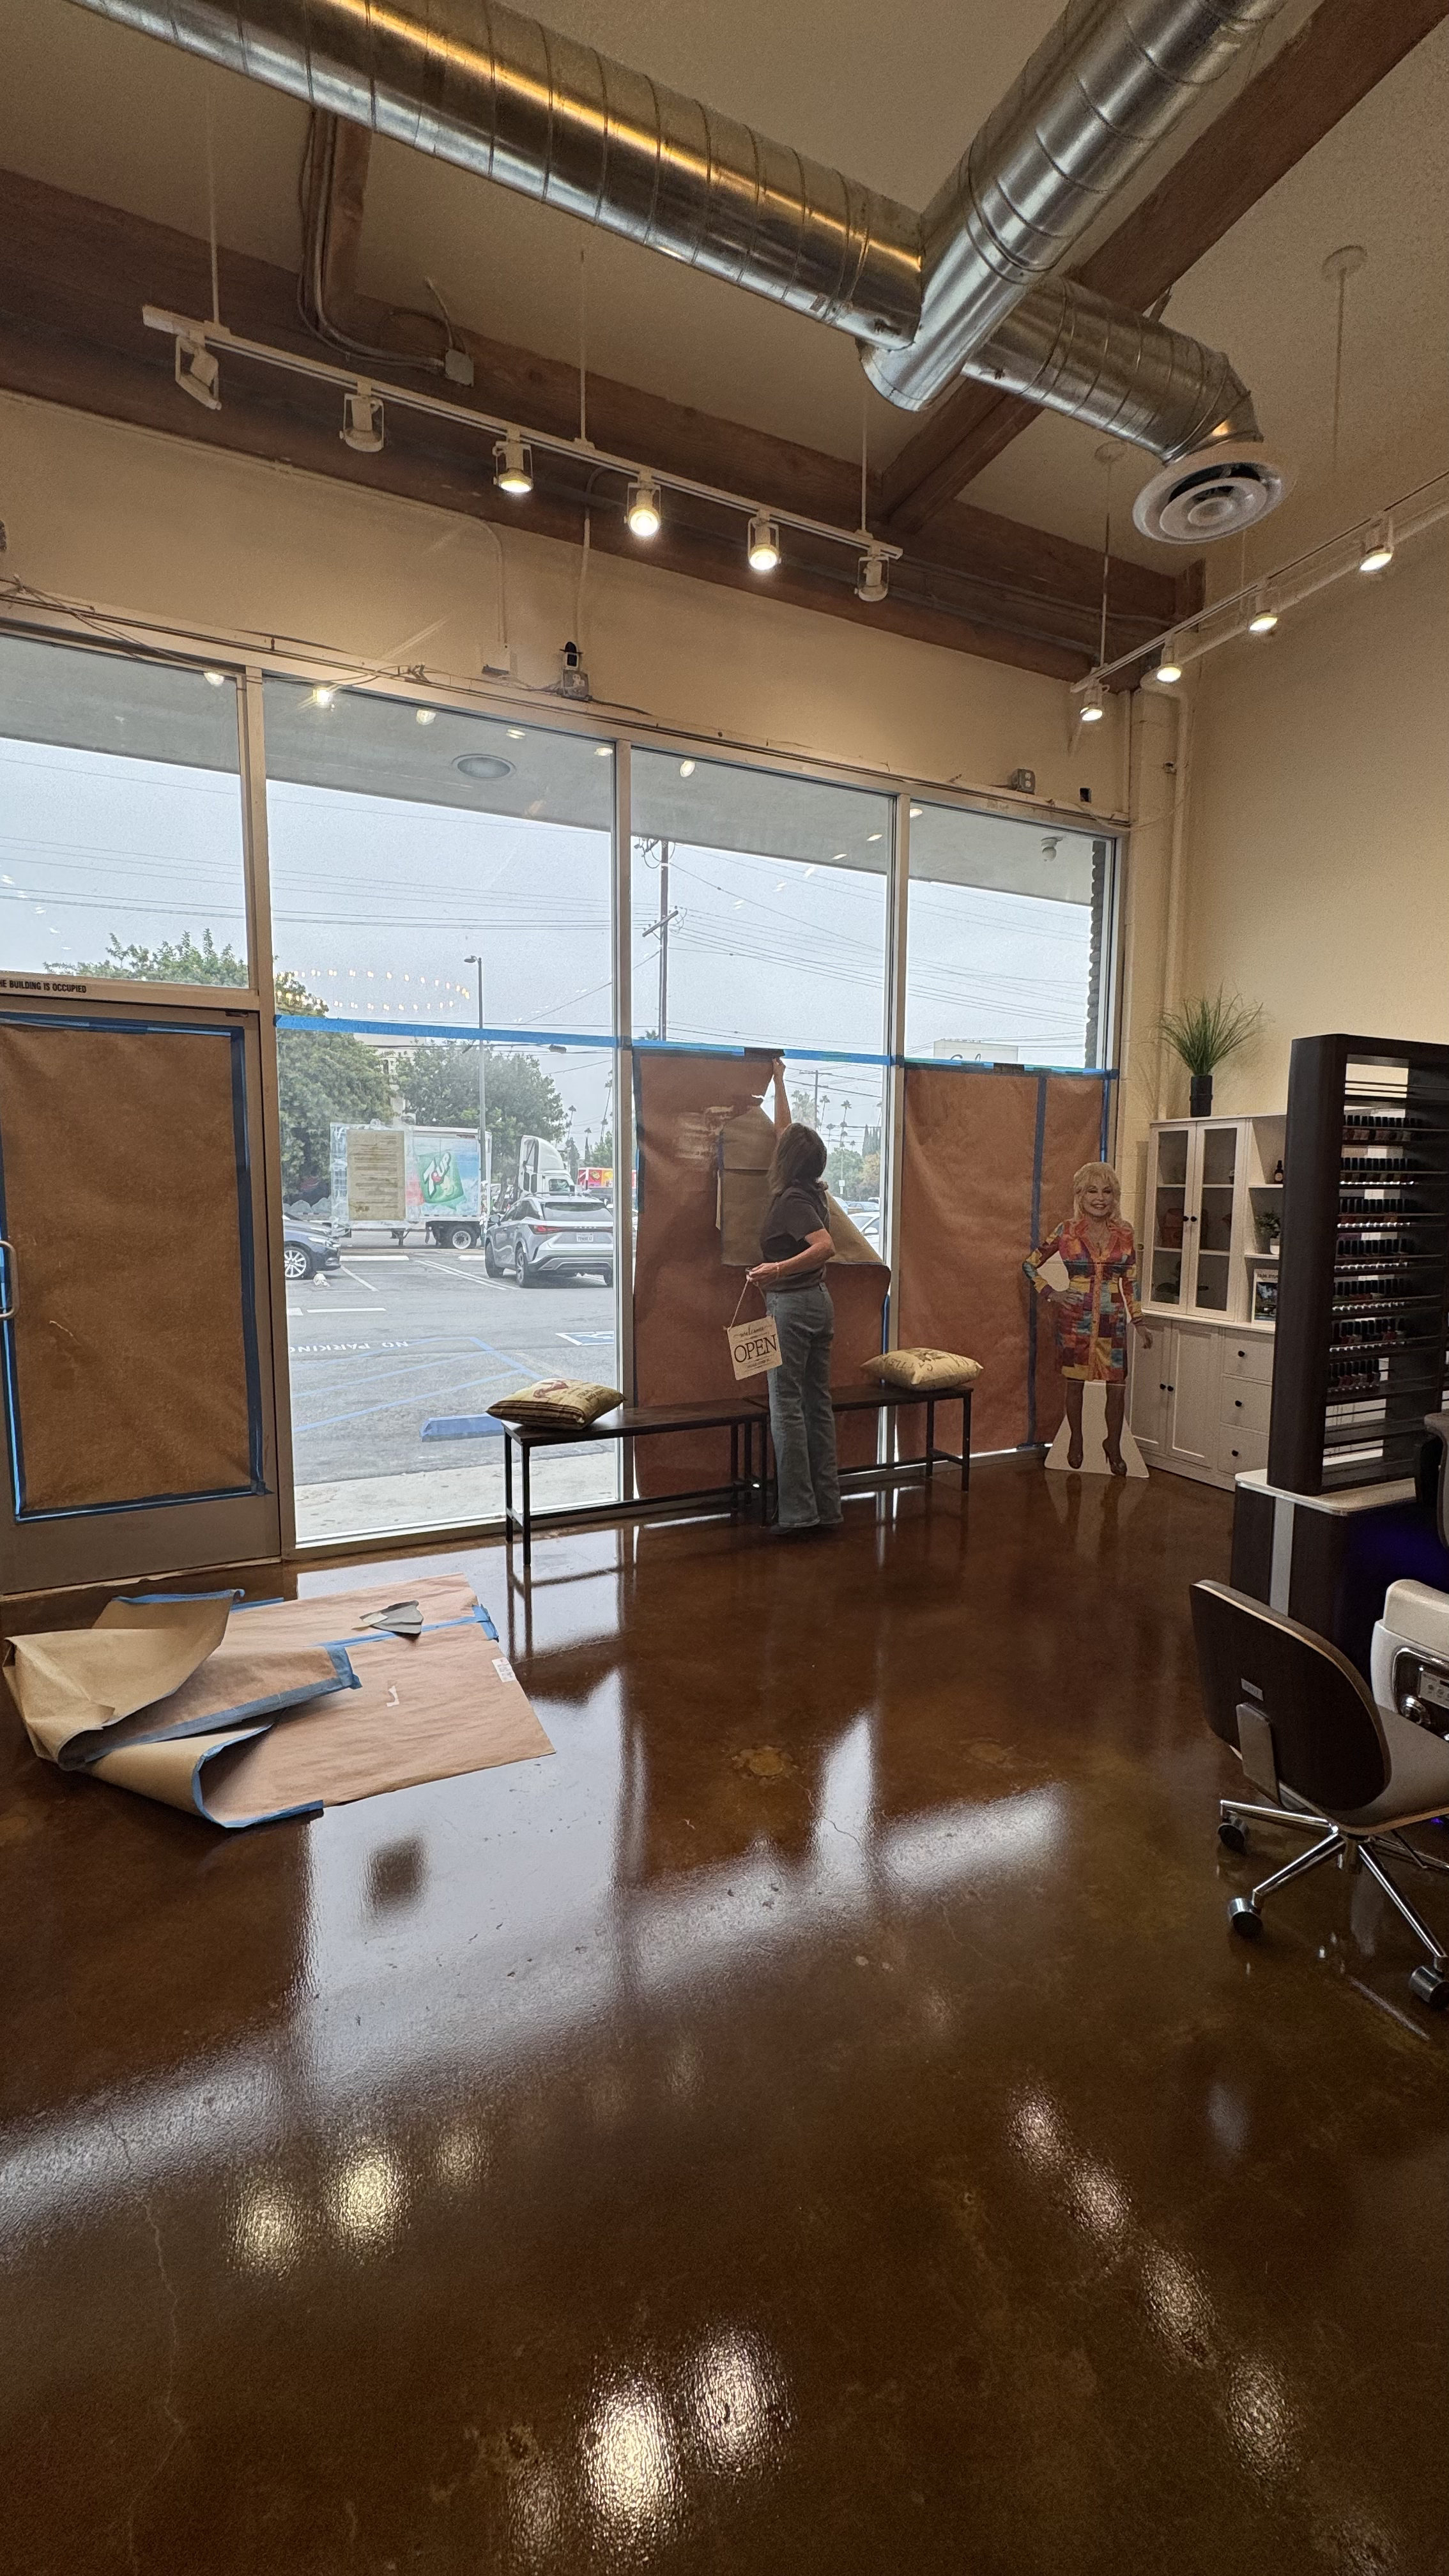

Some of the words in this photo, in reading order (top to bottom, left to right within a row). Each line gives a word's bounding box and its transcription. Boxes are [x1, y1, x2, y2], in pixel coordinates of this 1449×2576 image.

[9, 980, 42, 990] BUILDING
[43, 982, 50, 991] IS
[52, 983, 87, 993] OCCUPIED
[734, 1334, 777, 1363] OPEN
